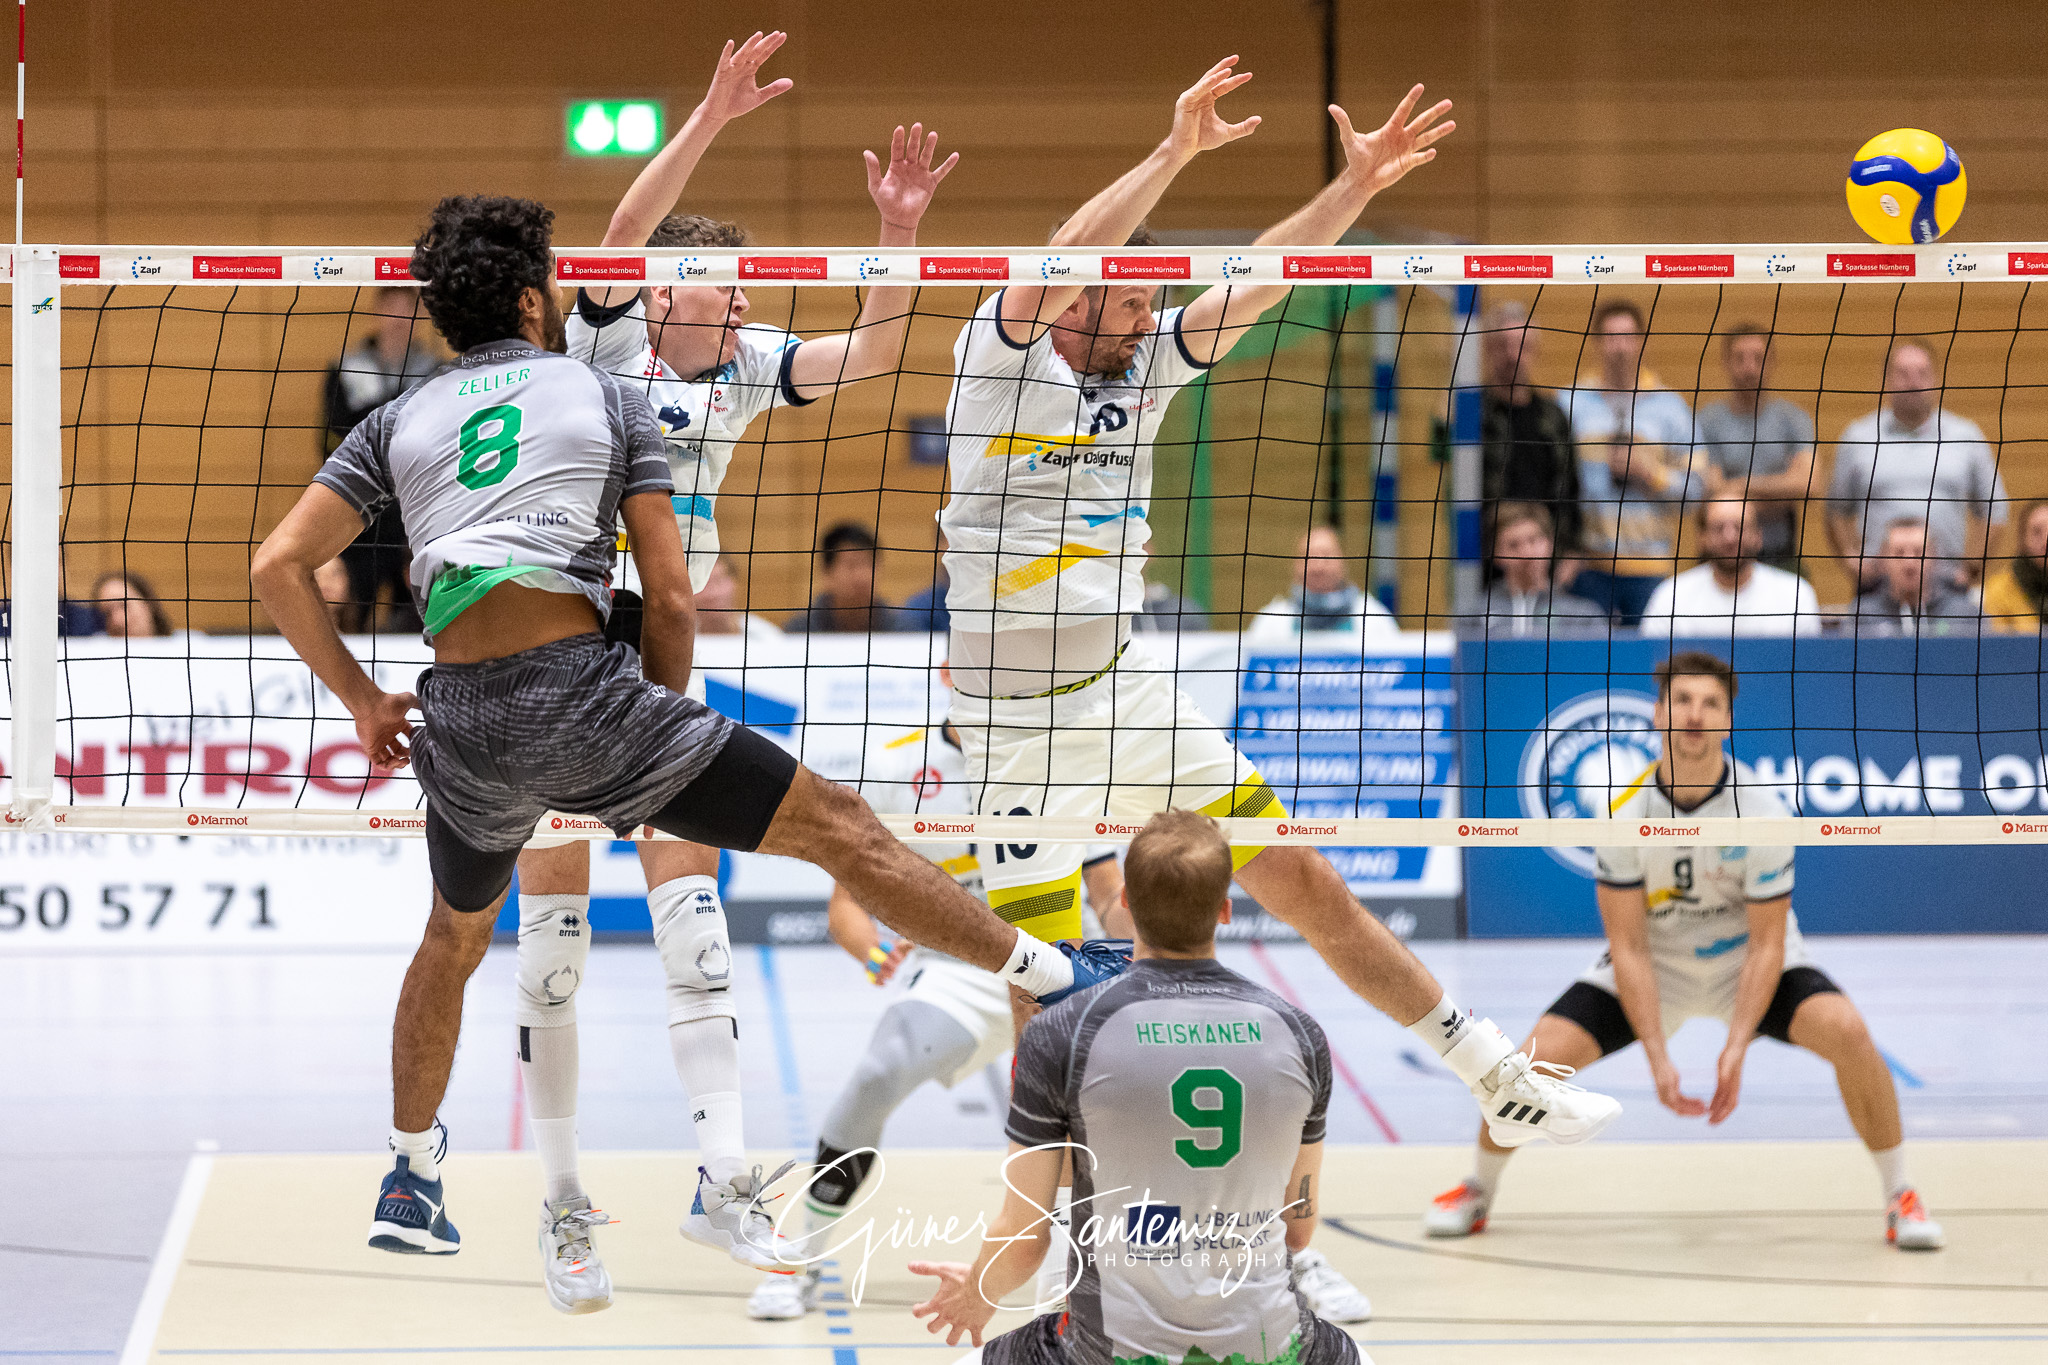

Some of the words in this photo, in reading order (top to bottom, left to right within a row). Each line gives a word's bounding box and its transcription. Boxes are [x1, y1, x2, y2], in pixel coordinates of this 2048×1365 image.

[62, 264, 93, 274] Nürnberg
[140, 265, 161, 275] Zapf
[211, 265, 243, 274] Sparkasse
[244, 265, 275, 274] Nürnberg
[322, 266, 343, 276] Zapf
[575, 266, 607, 275] Sparkasse
[608, 266, 639, 275] Nürnberg
[686, 266, 707, 276] Zapf
[757, 265, 789, 274] Sparkasse
[790, 265, 821, 274] Nürnberg
[868, 266, 889, 275] Zapf
[939, 266, 971, 275] Sparkasse
[972, 266, 1003, 275] Nürnberg
[1049, 266, 1070, 275] Zapf
[1120, 265, 1152, 274] Sparkasse
[1153, 265, 1184, 274] Nürnberg
[1231, 265, 1252, 275] Zapf
[1301, 265, 1333, 274] Sparkasse
[1334, 265, 1365, 274] Nürnberg
[1412, 265, 1433, 274] Zapf
[1483, 264, 1515, 273] Sparkasse
[1516, 264, 1547, 273] Nürnberg
[1593, 264, 1614, 274] Zapf
[1664, 263, 1696, 272] Sparkasse
[1697, 263, 1728, 272] Nürnberg
[1775, 263, 1795, 273] Zapf
[1845, 262, 1877, 271] Sparkasse
[1878, 262, 1909, 271] Nürnberg
[1956, 262, 1977, 272] Zapf
[2027, 262, 2048, 270] Sparka
[461, 352, 489, 366] local
[492, 349, 536, 360] heroes
[458, 368, 531, 396] ZELLER
[456, 402, 524, 491] 8
[1041, 451, 1080, 469] Zapf
[1754, 755, 1965, 813] HOME
[1981, 754, 2048, 812] O
[201, 815, 249, 825] Marmot
[382, 818, 427, 828] Marmo
[927, 823, 976, 833] Marmot
[1108, 824, 1144, 834] Marm
[1290, 825, 1338, 835] Marmot
[1471, 826, 1519, 836] Marmot
[1653, 826, 1701, 836] Marmot
[1834, 825, 1882, 835] Marmot
[2015, 823, 2048, 833] Marm
[1675, 856, 1694, 890] 9
[0, 885, 71, 930] 50
[101, 884, 175, 930] 57
[206, 884, 276, 929] 71
[1146, 981, 1181, 994] local
[1182, 982, 1231, 995] heroes
[1136, 1022, 1263, 1044] HEISKANEN
[1170, 1067, 1245, 1169] 9
